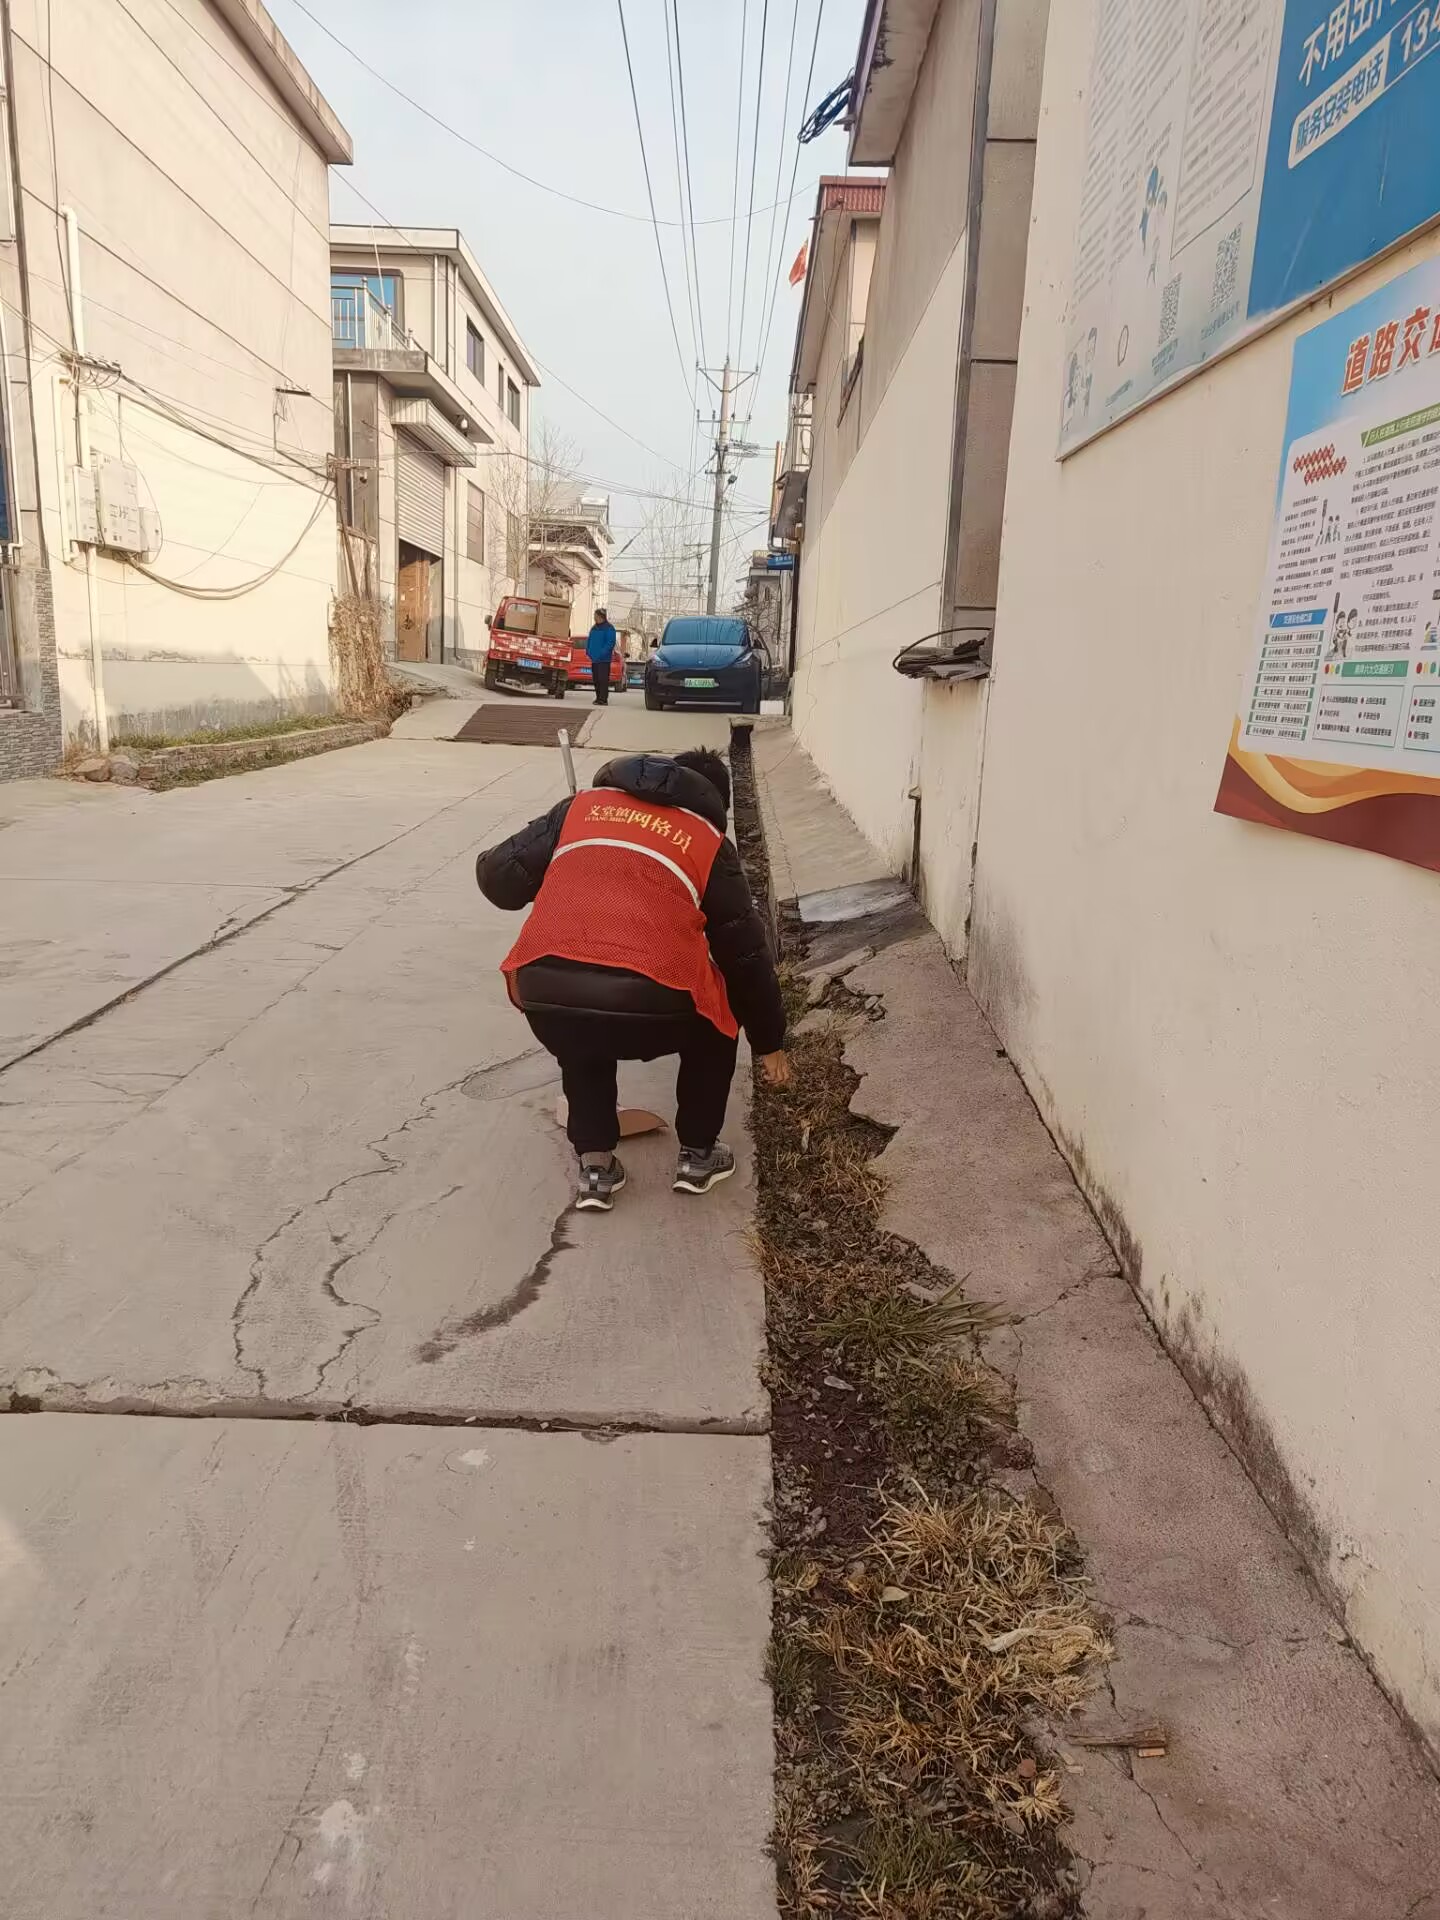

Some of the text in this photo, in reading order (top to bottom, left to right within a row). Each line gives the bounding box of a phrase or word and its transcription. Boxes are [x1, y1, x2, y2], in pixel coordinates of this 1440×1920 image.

[1299, 0, 1398, 87] 不用出
[1295, 50, 1385, 154] 服务安装电话
